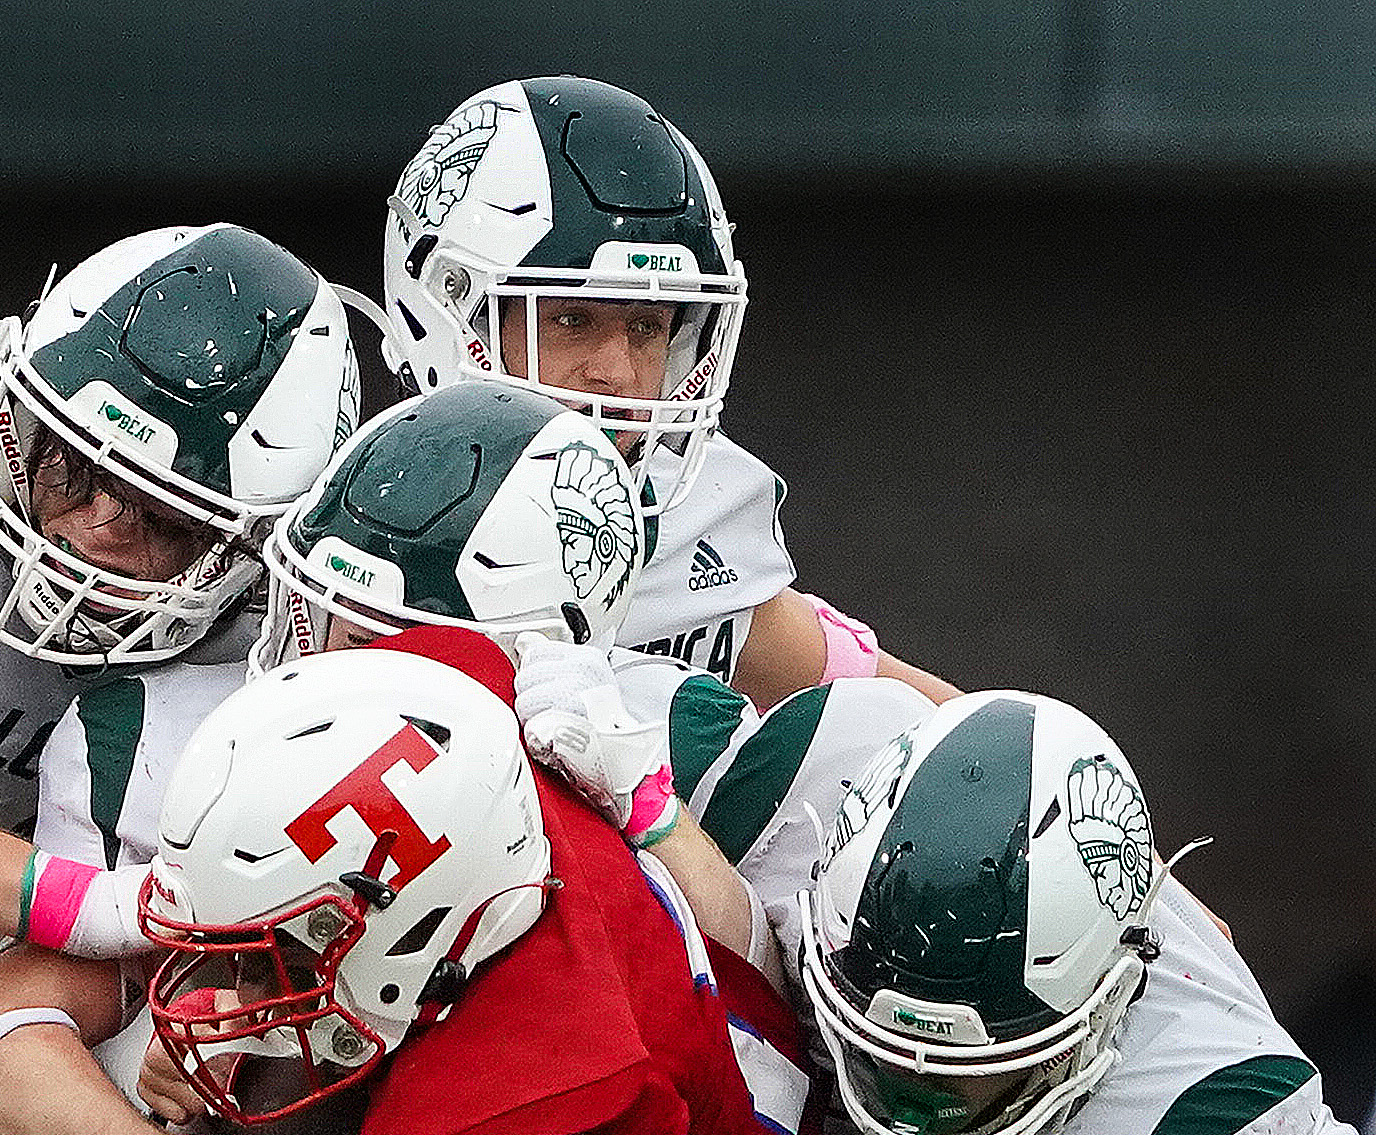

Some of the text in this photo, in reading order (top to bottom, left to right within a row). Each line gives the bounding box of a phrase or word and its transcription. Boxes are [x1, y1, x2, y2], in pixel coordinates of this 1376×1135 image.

[650, 255, 683, 271] BEAT
[118, 413, 157, 444] BEAT
[688, 566, 739, 592] adidas
[284, 721, 453, 896] T
